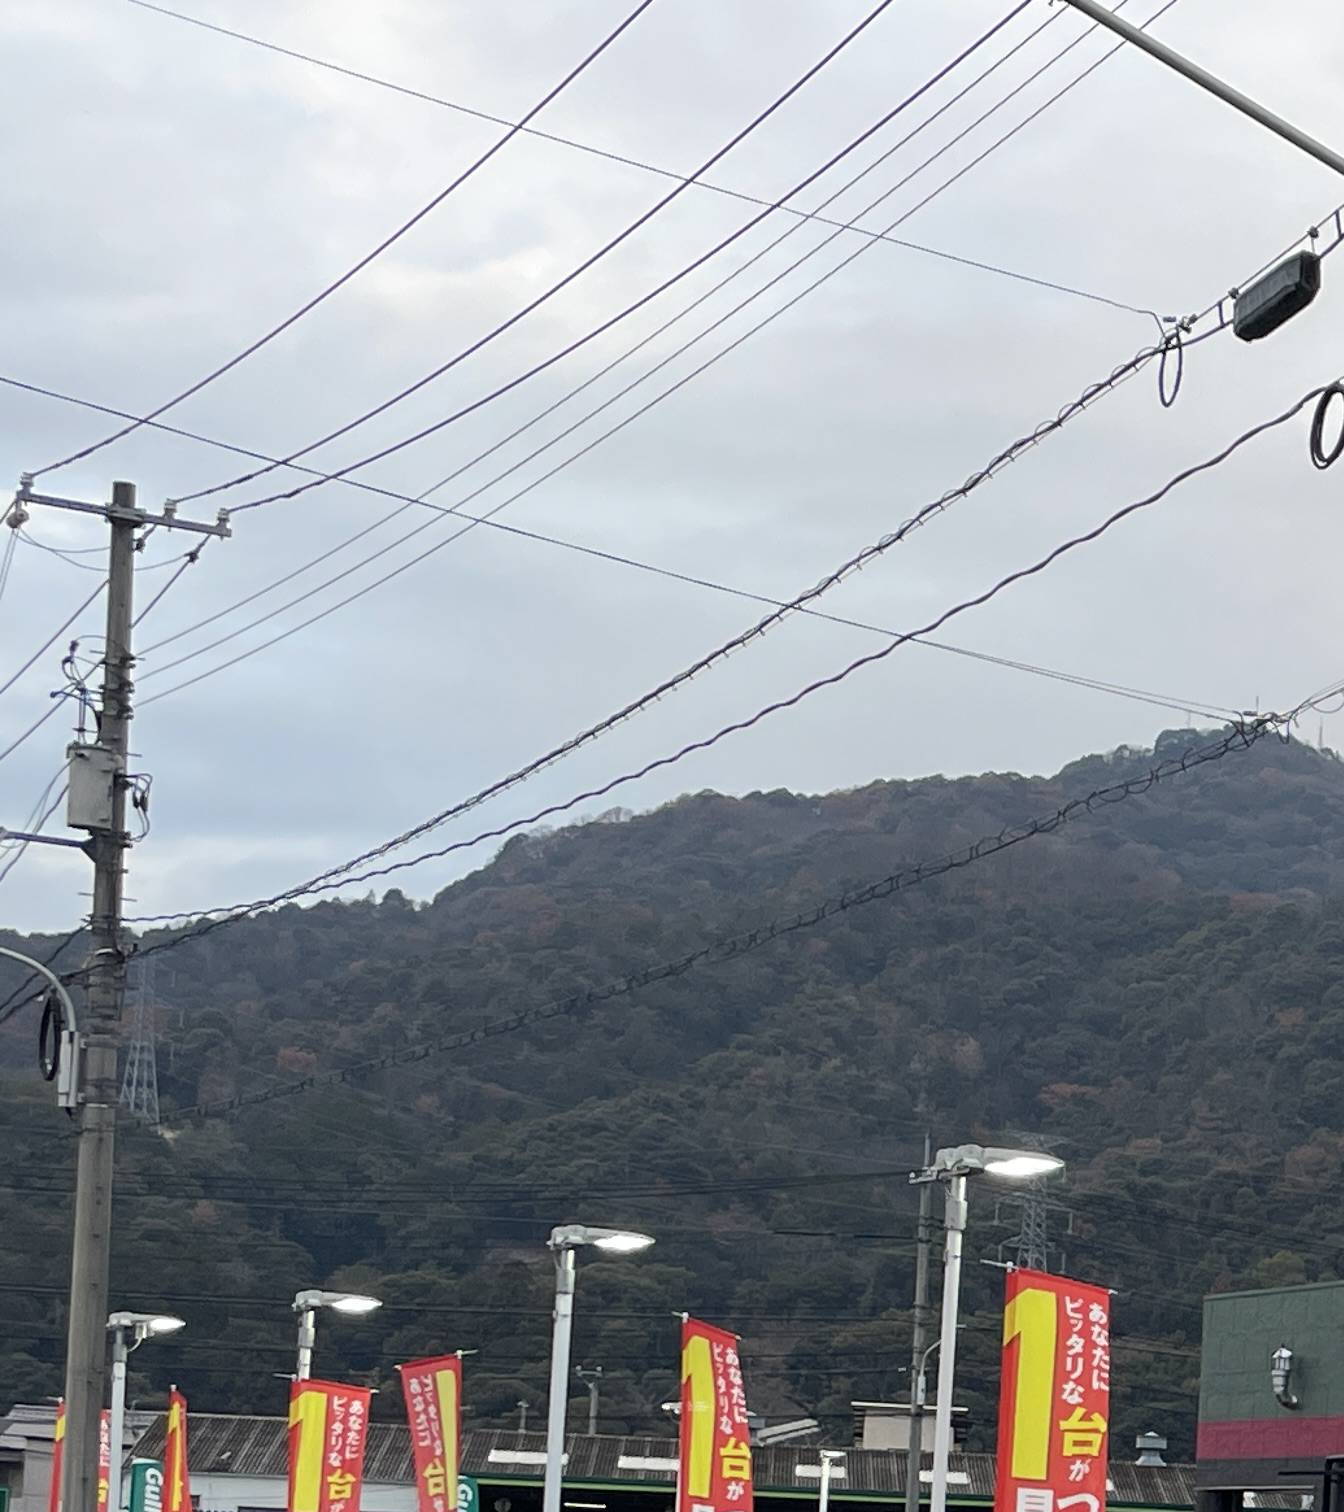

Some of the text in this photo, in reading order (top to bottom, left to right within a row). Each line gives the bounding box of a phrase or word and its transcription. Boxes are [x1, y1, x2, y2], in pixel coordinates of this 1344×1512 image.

[726, 1348, 748, 1424] あなたに
[1003, 1288, 1056, 1480] 1
[1062, 1296, 1086, 1404] ピッタリな
[1089, 1302, 1109, 1391] あなたに
[345, 1400, 365, 1459] あなたに
[682, 1335, 715, 1498] 1
